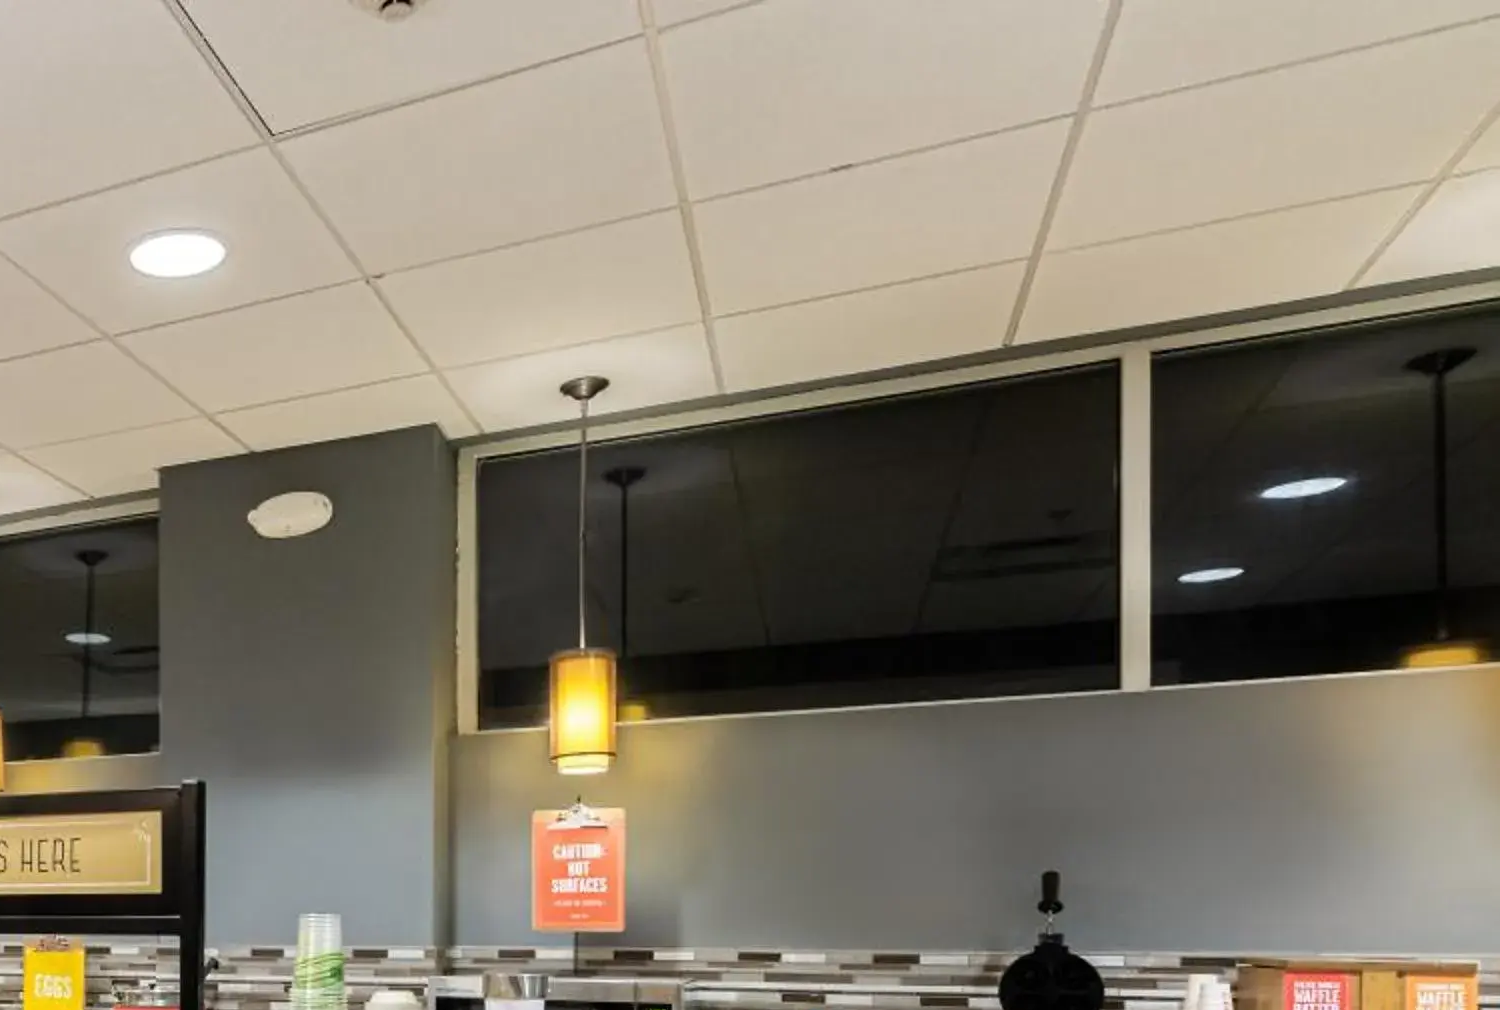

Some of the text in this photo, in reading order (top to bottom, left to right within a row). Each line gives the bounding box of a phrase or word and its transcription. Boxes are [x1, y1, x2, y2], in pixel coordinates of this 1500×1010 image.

[20, 837, 82, 873] HERE
[566, 861, 591, 877] HOT
[551, 877, 608, 894] SURFACES
[34, 973, 73, 999] EGGS
[1294, 988, 1341, 1004] WAFFLE
[1416, 991, 1467, 1006] WAFFLE
